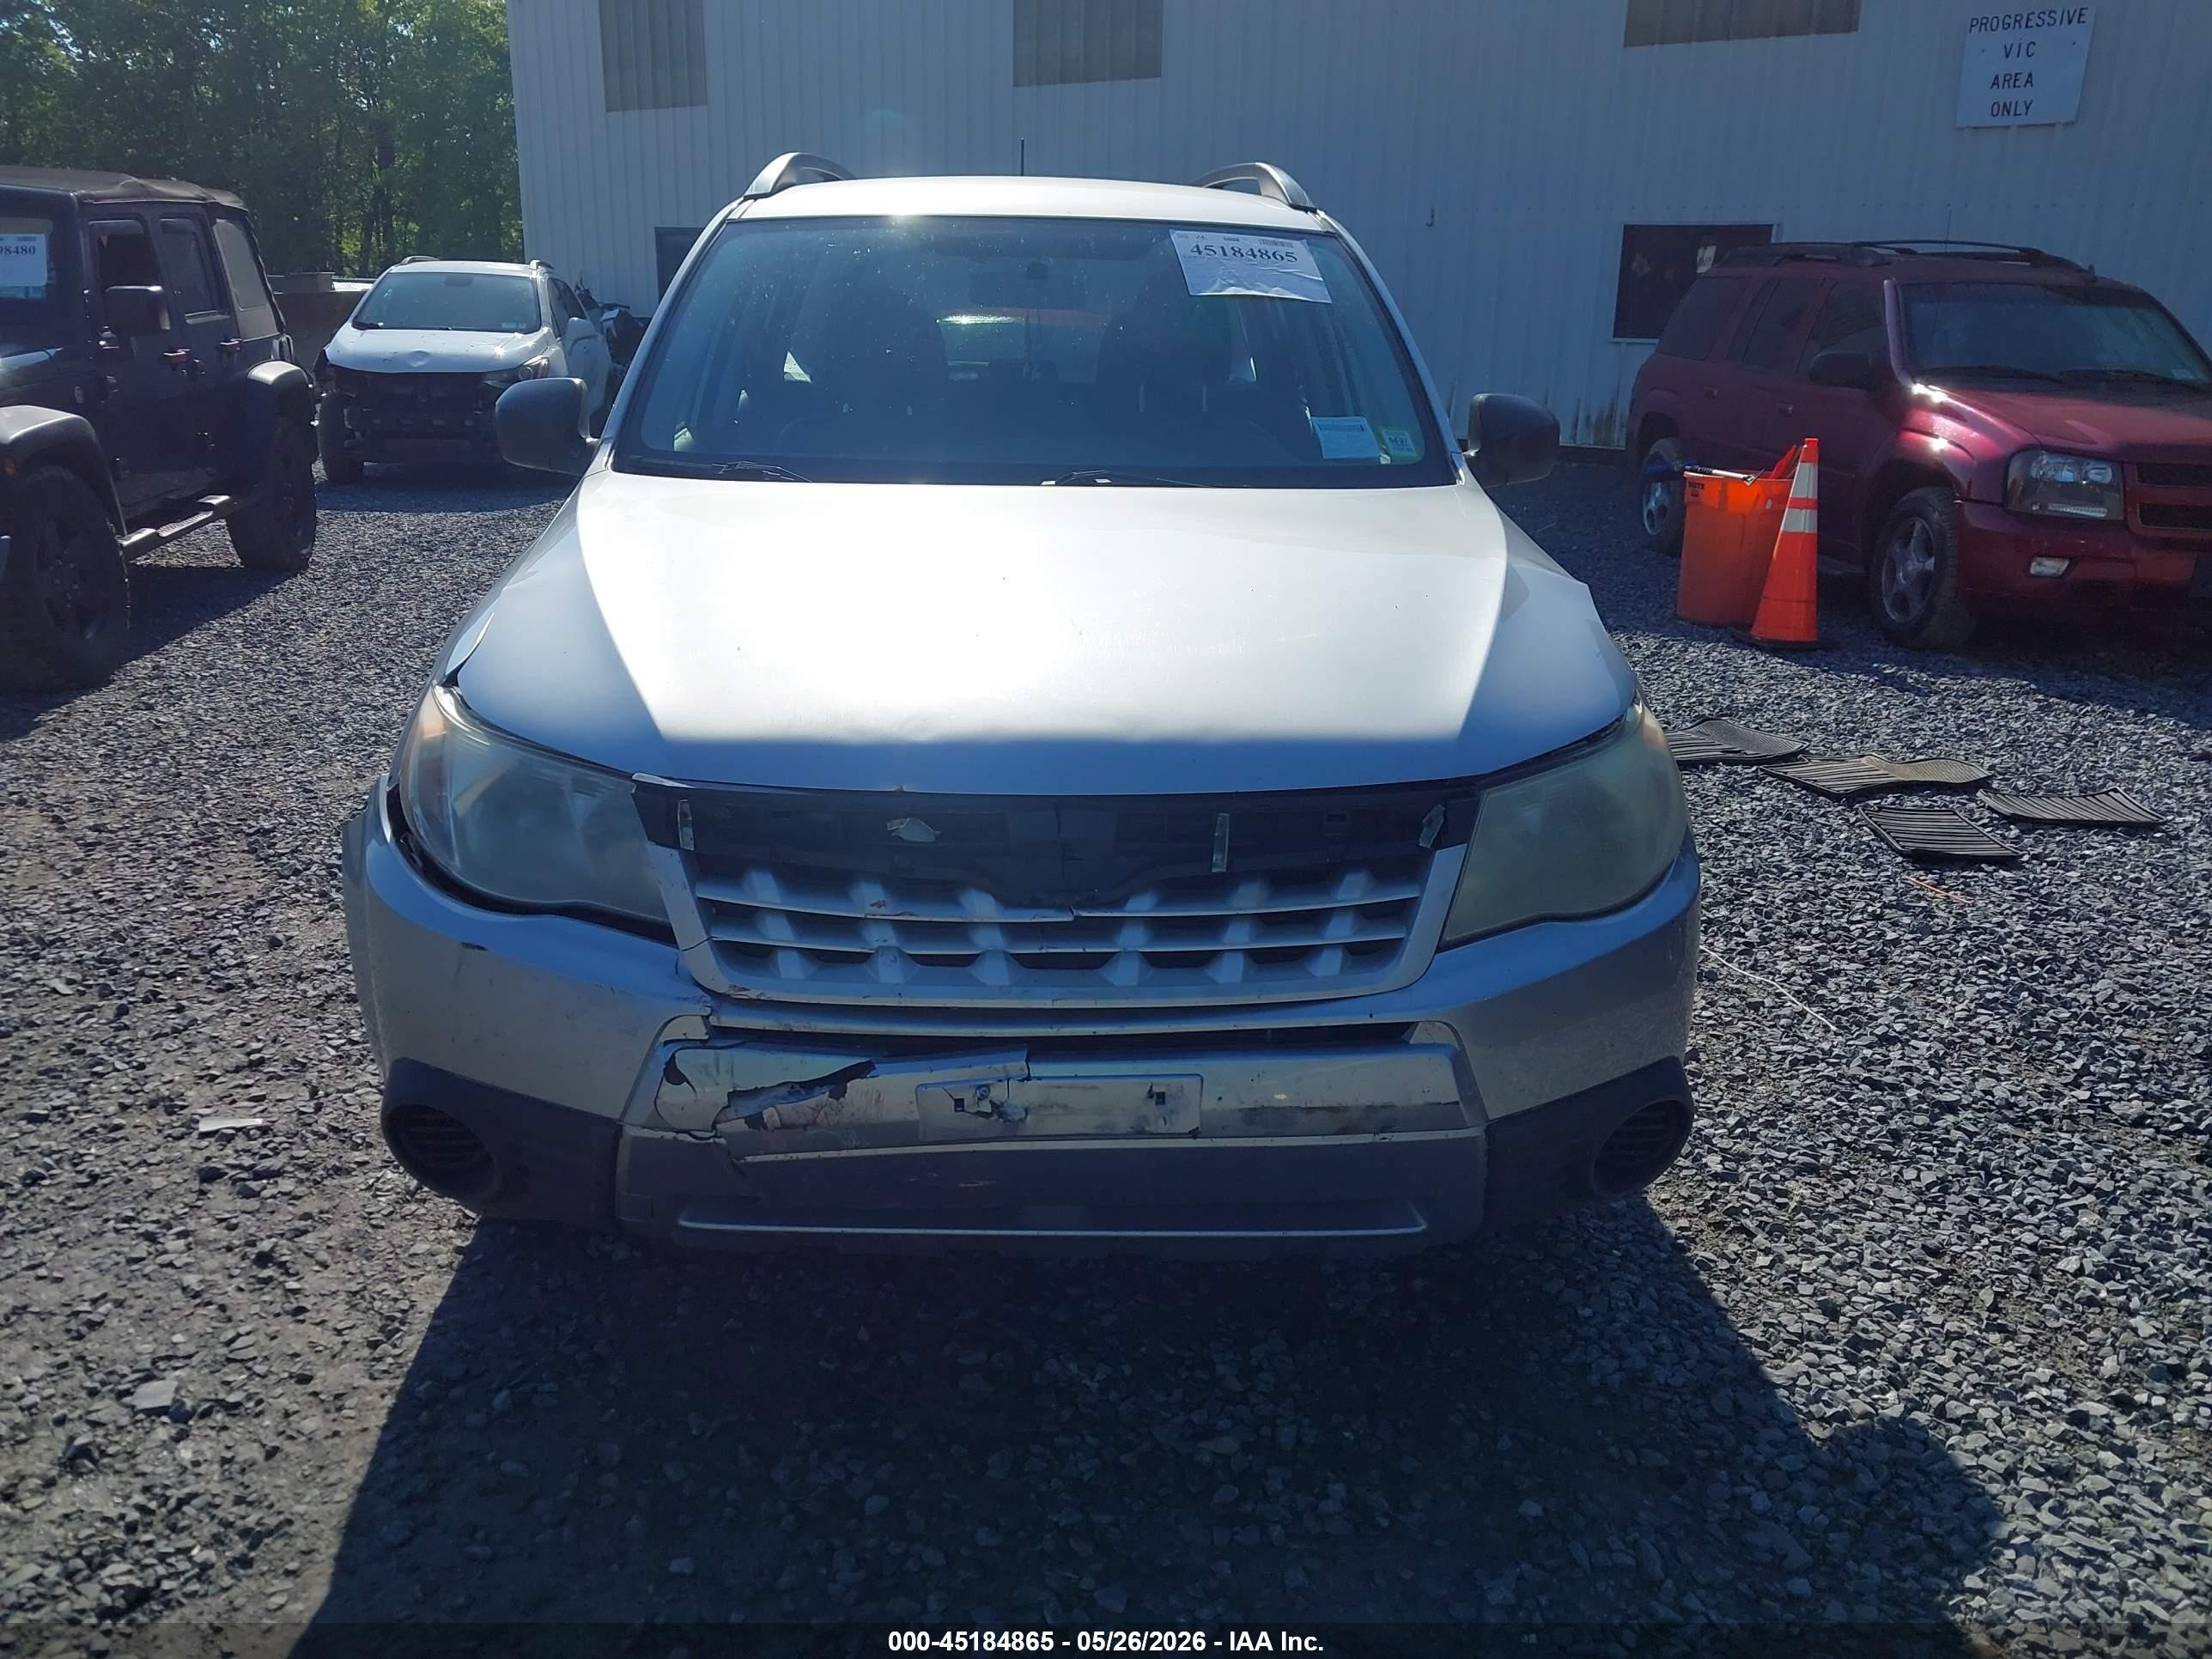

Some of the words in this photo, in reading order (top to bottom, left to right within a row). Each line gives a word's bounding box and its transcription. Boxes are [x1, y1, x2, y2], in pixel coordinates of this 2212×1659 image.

[1969, 7, 2088, 33] PROGRESSIVE
[2003, 41, 2036, 59] VIC
[1990, 72, 2033, 89] AREA
[1990, 100, 2033, 117] ONLY
[1190, 244, 1297, 263] 45184865
